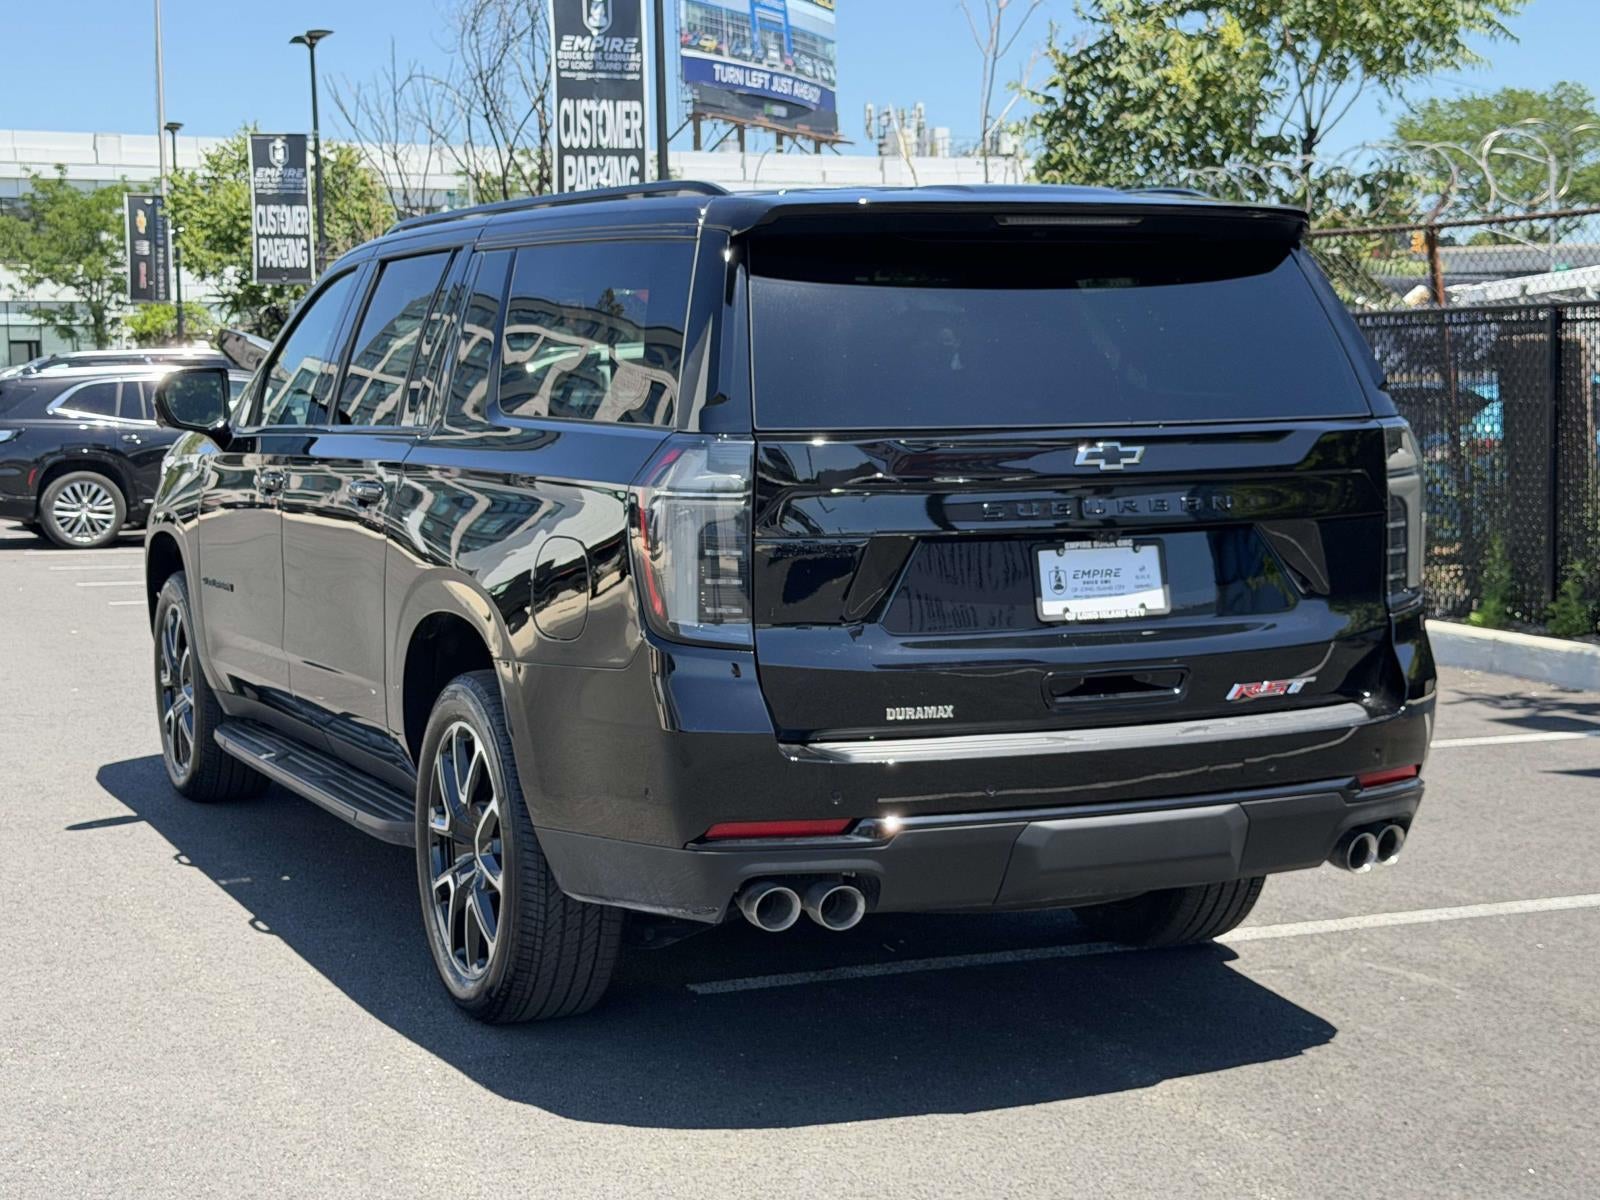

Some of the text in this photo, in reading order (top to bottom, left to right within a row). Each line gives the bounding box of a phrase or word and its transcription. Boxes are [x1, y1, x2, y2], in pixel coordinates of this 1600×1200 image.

[559, 34, 639, 53] EMPIRE
[557, 60, 570, 70] OF
[570, 60, 594, 71] LONG
[712, 63, 745, 86] TURN
[744, 69, 771, 91] LEFT
[770, 74, 794, 96] JUST
[559, 97, 643, 150] CUSTOMER
[255, 166, 305, 178] EMPIRE
[562, 154, 640, 194] PARKING
[256, 204, 309, 236] CUSTOMER
[258, 237, 308, 268] PARKING
[983, 495, 1232, 520] SUBURBAN
[1072, 567, 1122, 580] EMPIRE
[1225, 676, 1317, 702] RST
[886, 705, 955, 721] DURAMAX
